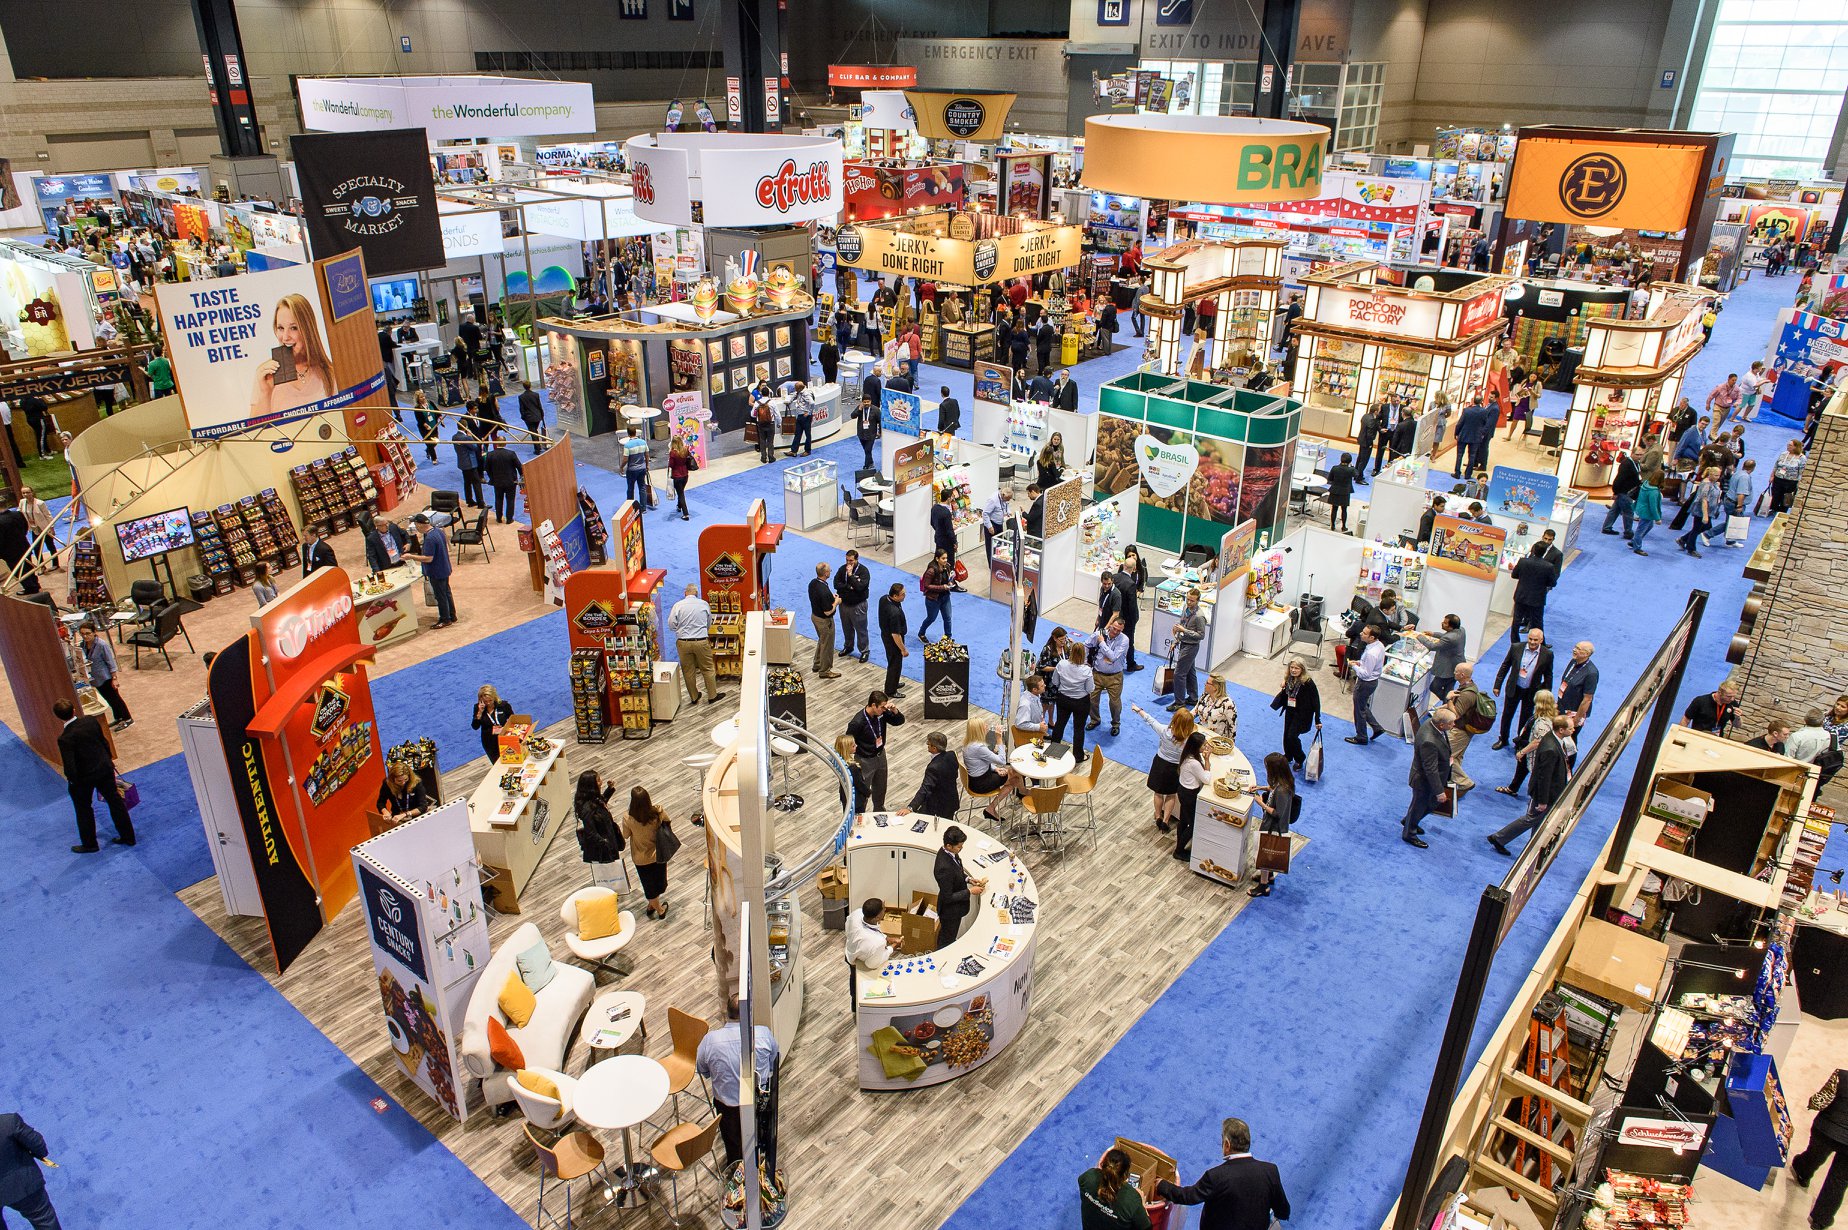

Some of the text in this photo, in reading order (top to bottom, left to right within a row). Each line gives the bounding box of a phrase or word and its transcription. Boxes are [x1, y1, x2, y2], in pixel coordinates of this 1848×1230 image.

[1150, 34, 1184, 49] EXIT
[1190, 34, 1210, 49] TO
[1301, 34, 1336, 50] AVE
[924, 45, 1038, 60] EMERGENCY EXIT
[948, 110, 980, 118] COUNTRY
[950, 117, 978, 126] SMOKER
[1237, 140, 1325, 190] BRA
[332, 175, 405, 200] SPECIALTY
[756, 158, 831, 213] efrutti
[367, 201, 377, 211] &
[395, 198, 418, 206] SNACKS
[344, 213, 404, 235] MARKET
[837, 236, 860, 245] COUNTRY
[839, 242, 860, 252] SMOKER
[896, 237, 929, 256] JERKY
[1025, 234, 1051, 253] JERKY
[882, 253, 944, 276] DONE RIGHT
[974, 249, 996, 264] COUNTRY
[1014, 249, 1062, 273] DONE RIGHT
[190, 288, 240, 309] TASTE
[1350, 299, 1406, 316] POPCORN
[174, 303, 262, 331] HAPPINESS
[1350, 310, 1403, 326] FACTORY
[187, 322, 258, 348] IN EVERY
[1820, 326, 1839, 337] VIDAL
[207, 344, 248, 364] BITE.
[2, 368, 125, 398] PERKY JERKY
[324, 391, 354, 409] AFFORDABLE
[196, 422, 246, 439] AFFORDABLE
[282, 404, 319, 419] CHOCOLATE
[1160, 450, 1190, 465] BRASIL
[318, 701, 342, 722] BORDER
[319, 707, 327, 716] ON
[242, 742, 280, 866] AUTHENTIC
[378, 916, 414, 953] CENTURY
[386, 936, 412, 963] SNACKS
